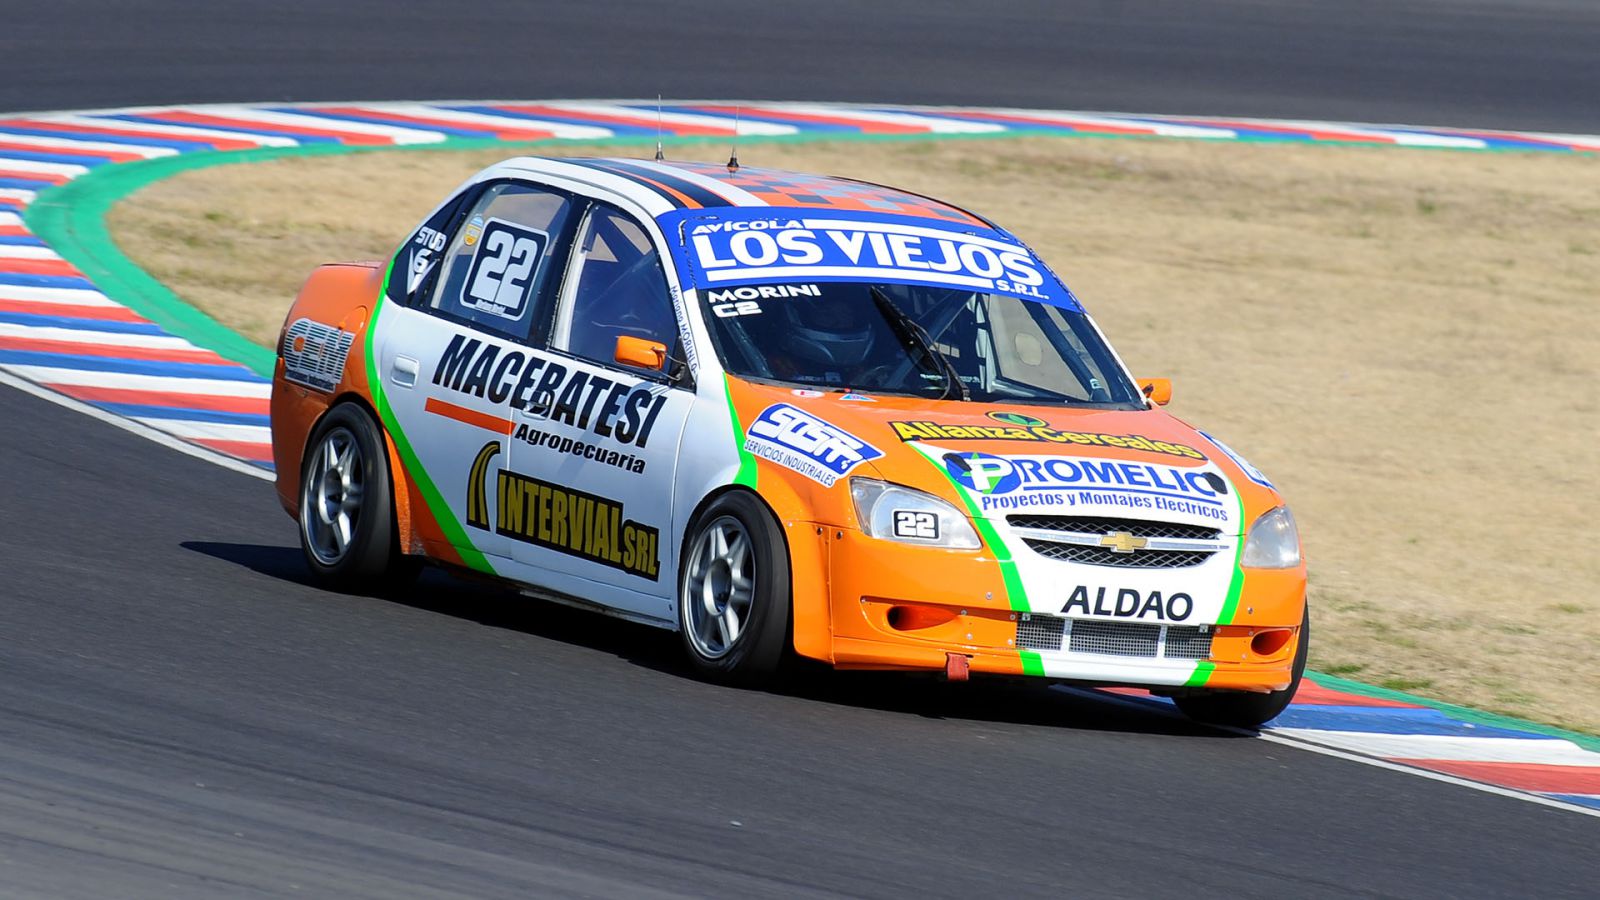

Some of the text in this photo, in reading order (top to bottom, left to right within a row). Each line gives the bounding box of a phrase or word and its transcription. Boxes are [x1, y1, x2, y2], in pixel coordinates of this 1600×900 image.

[415, 226, 447, 252] STUD
[469, 230, 538, 309] 22
[692, 229, 1044, 287] LOS VIEJOS
[708, 284, 822, 303] MORINI
[996, 279, 1050, 300] S.R.L.
[712, 301, 763, 318] C2
[514, 423, 646, 474] Agropecuaria
[892, 421, 1206, 459] Alianza Cereales
[744, 439, 836, 487] SERVICIOS INDUSTRIALES
[497, 473, 657, 575] INTERVIAL SRL
[982, 491, 1229, 521] Proyectos y Montajes Electricos
[897, 513, 937, 538] 22
[1060, 585, 1194, 622] ALDAO
